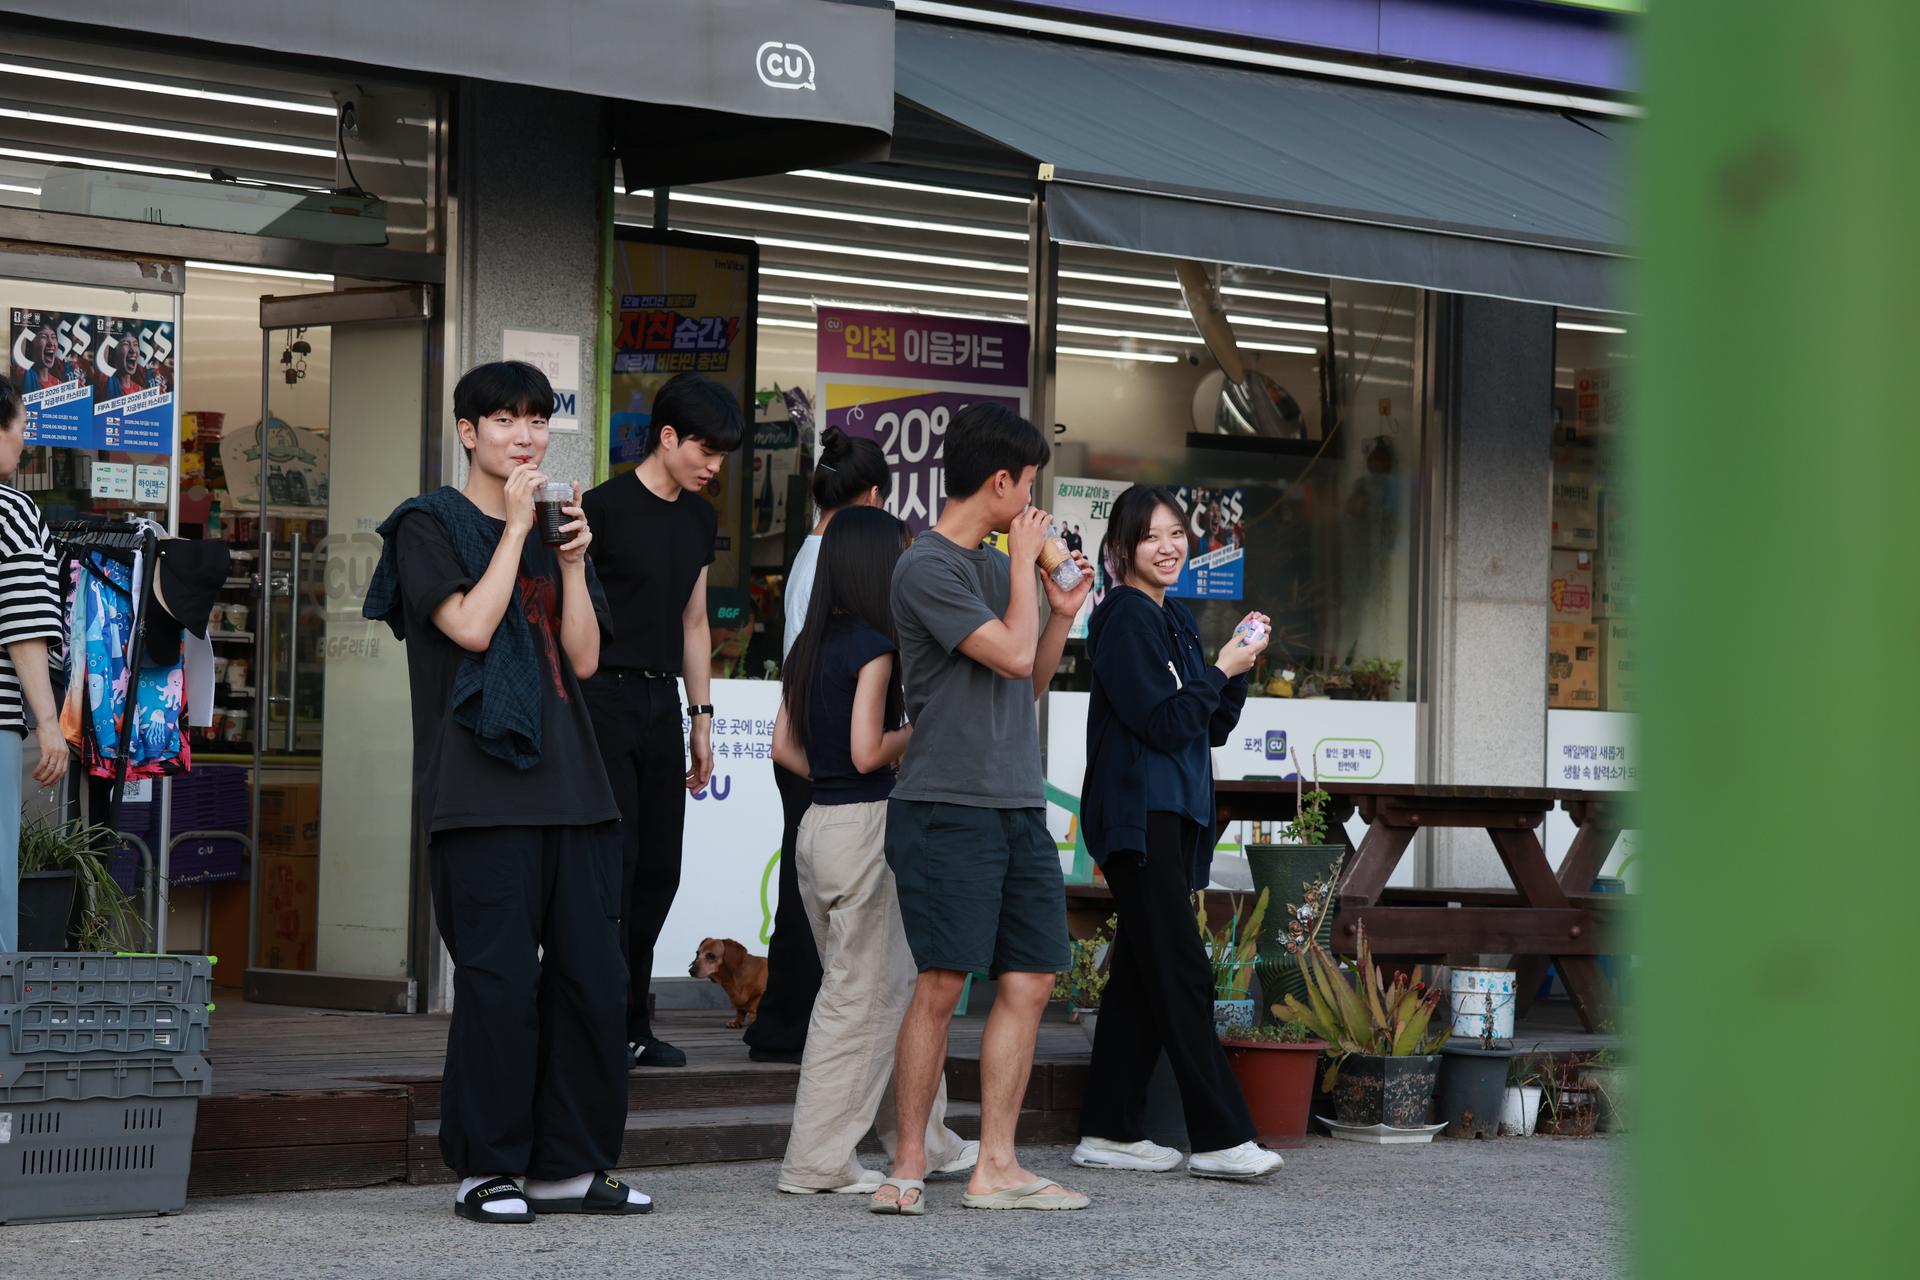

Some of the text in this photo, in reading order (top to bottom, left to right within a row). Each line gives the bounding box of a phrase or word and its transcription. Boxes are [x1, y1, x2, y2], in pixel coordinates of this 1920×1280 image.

[767, 52, 803, 78] CU
[615, 311, 675, 350] 지친
[827, 320, 840, 329] CU
[844, 324, 1004, 370] 인천 이음카드
[614, 353, 655, 372] 빠르게
[656, 352, 695, 371] 비타민
[98, 403, 110, 412] FIFA
[111, 397, 127, 409] 월드컵
[127, 394, 142, 403] 2026
[138, 479, 165, 489] 하이패스
[145, 488, 159, 498] 충전
[324, 556, 374, 600] CU
[717, 607, 741, 619] BGF
[315, 635, 381, 658] BGF리테일
[712, 718, 728, 735] 운
[730, 719, 752, 735] 곳에
[718, 742, 730, 759] 속
[1243, 737, 1283, 753] 포켓 CU
[1563, 745, 1624, 761] 매일매일 새롭게
[1563, 765, 1580, 780] 생활
[1582, 766, 1591, 780] 속
